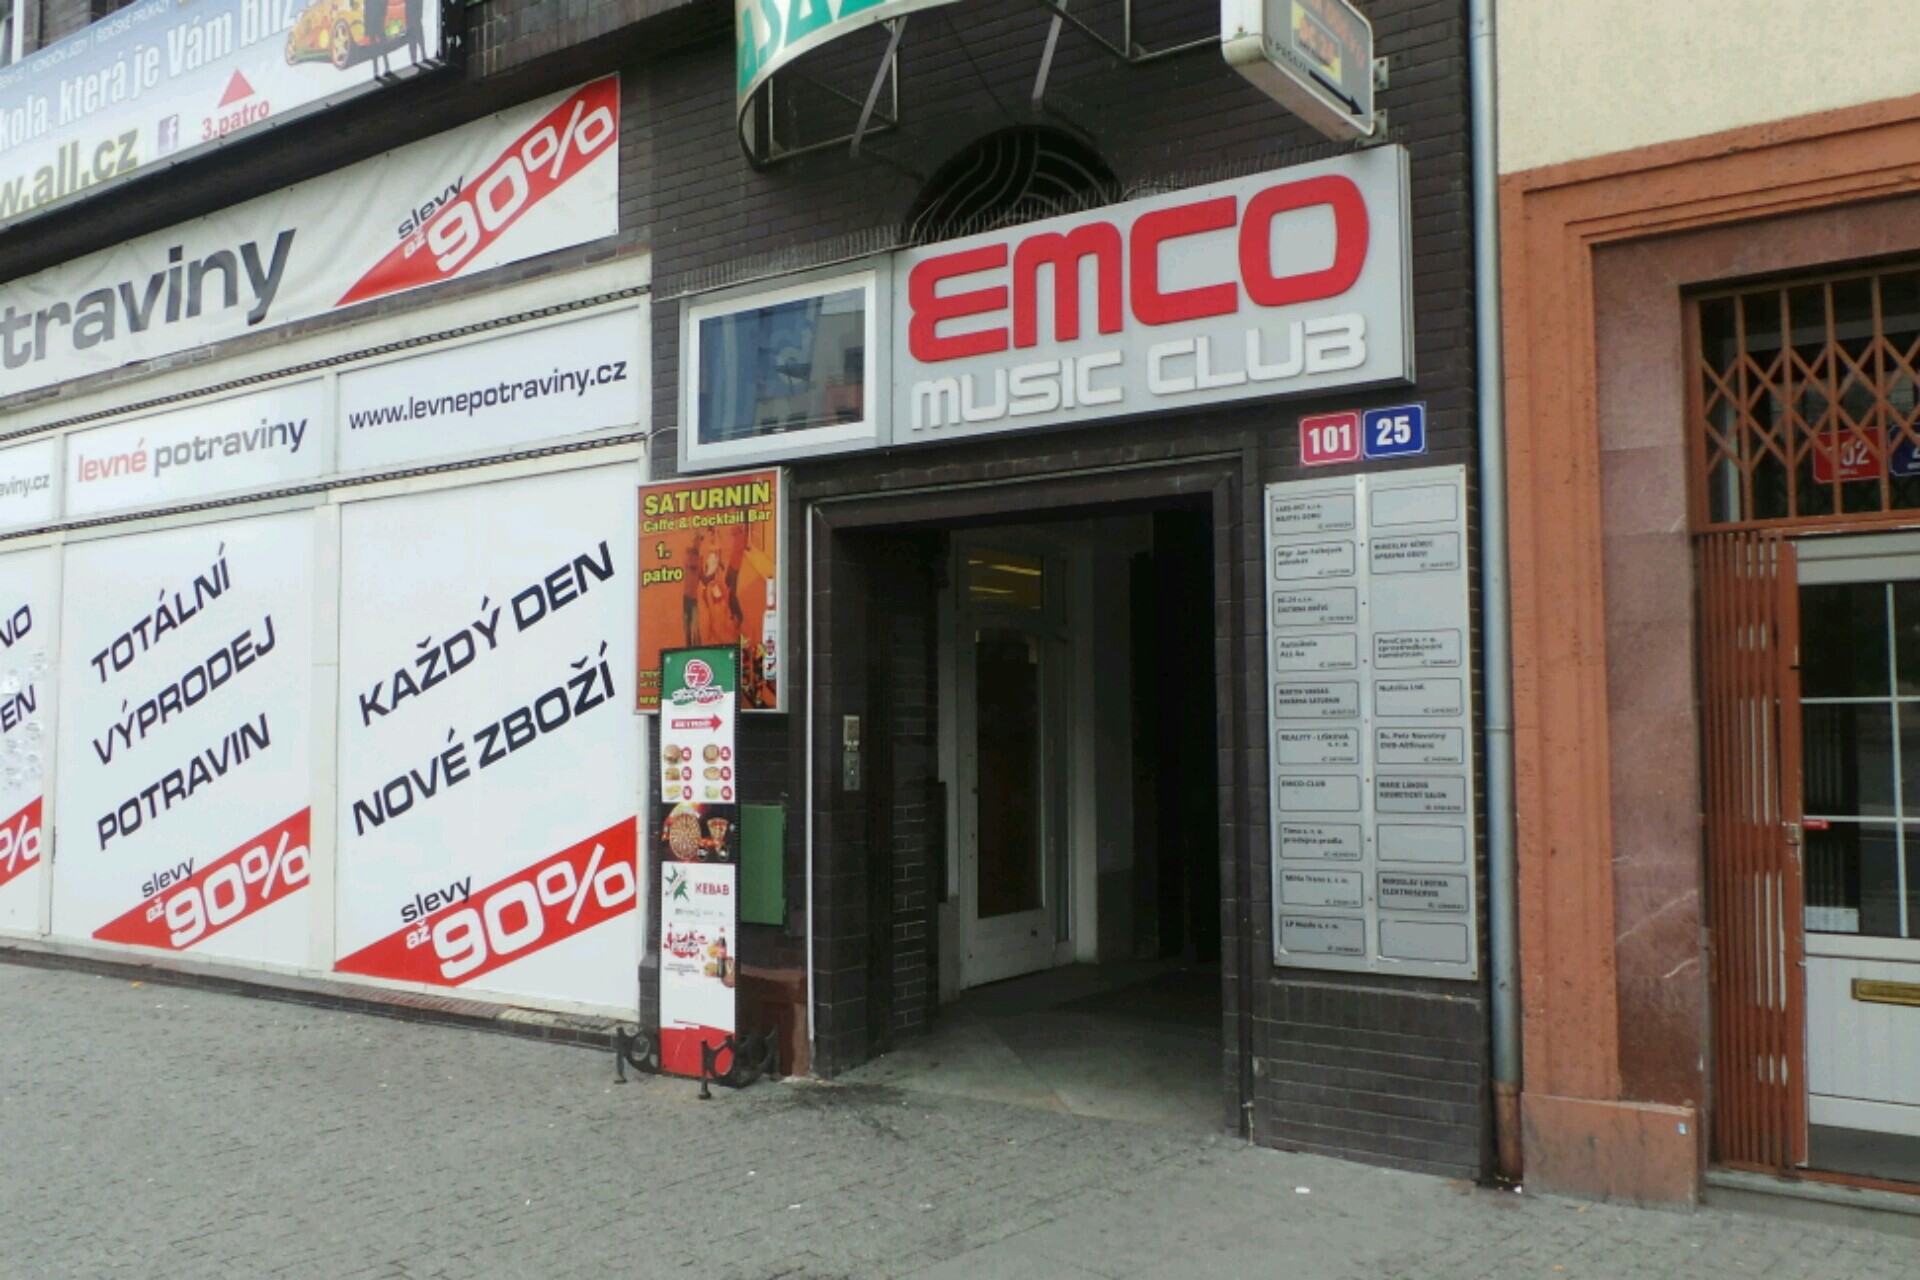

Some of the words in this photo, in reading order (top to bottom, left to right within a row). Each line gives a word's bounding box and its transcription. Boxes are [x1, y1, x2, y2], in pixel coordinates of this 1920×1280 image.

[60, 51, 127, 127] která
[132, 42, 160, 99] je
[167, 11, 232, 79] Vám
[202, 100, 270, 141] 3.patro
[397, 175, 464, 240] slevy
[426, 100, 615, 273] 90%
[0, 228, 297, 370] traviny
[908, 174, 1370, 363] EMCO
[349, 359, 628, 430] www.levnepotraviny.cz
[911, 349, 1123, 431] MUSIC
[1147, 312, 1367, 395] CLUB
[77, 437, 148, 483] levné
[153, 417, 309, 477] potraviny
[1308, 424, 1353, 456] 101
[1375, 414, 1411, 446] 25
[644, 481, 771, 516] SATURNIN
[679, 515, 689, 529] &
[692, 509, 744, 529] Cocktail
[748, 509, 772, 523] Bar
[642, 567, 684, 587] patro
[656, 541, 671, 559] 1.
[91, 541, 231, 683] TOTÁLNÍ
[358, 595, 502, 728] KAŽDÝ
[510, 540, 616, 632] DEN
[92, 615, 276, 766] VÝPRODEJ
[97, 712, 271, 852] POTRAVIN
[352, 727, 471, 837] NOVÉ
[474, 640, 616, 770] ZBOŽÍ
[141, 858, 195, 899] slevy
[145, 897, 166, 923] až
[165, 830, 310, 948] 90%
[400, 875, 473, 924] slevy
[406, 920, 431, 950] až
[431, 843, 636, 981] 90%
[694, 882, 730, 896] KEBAB
